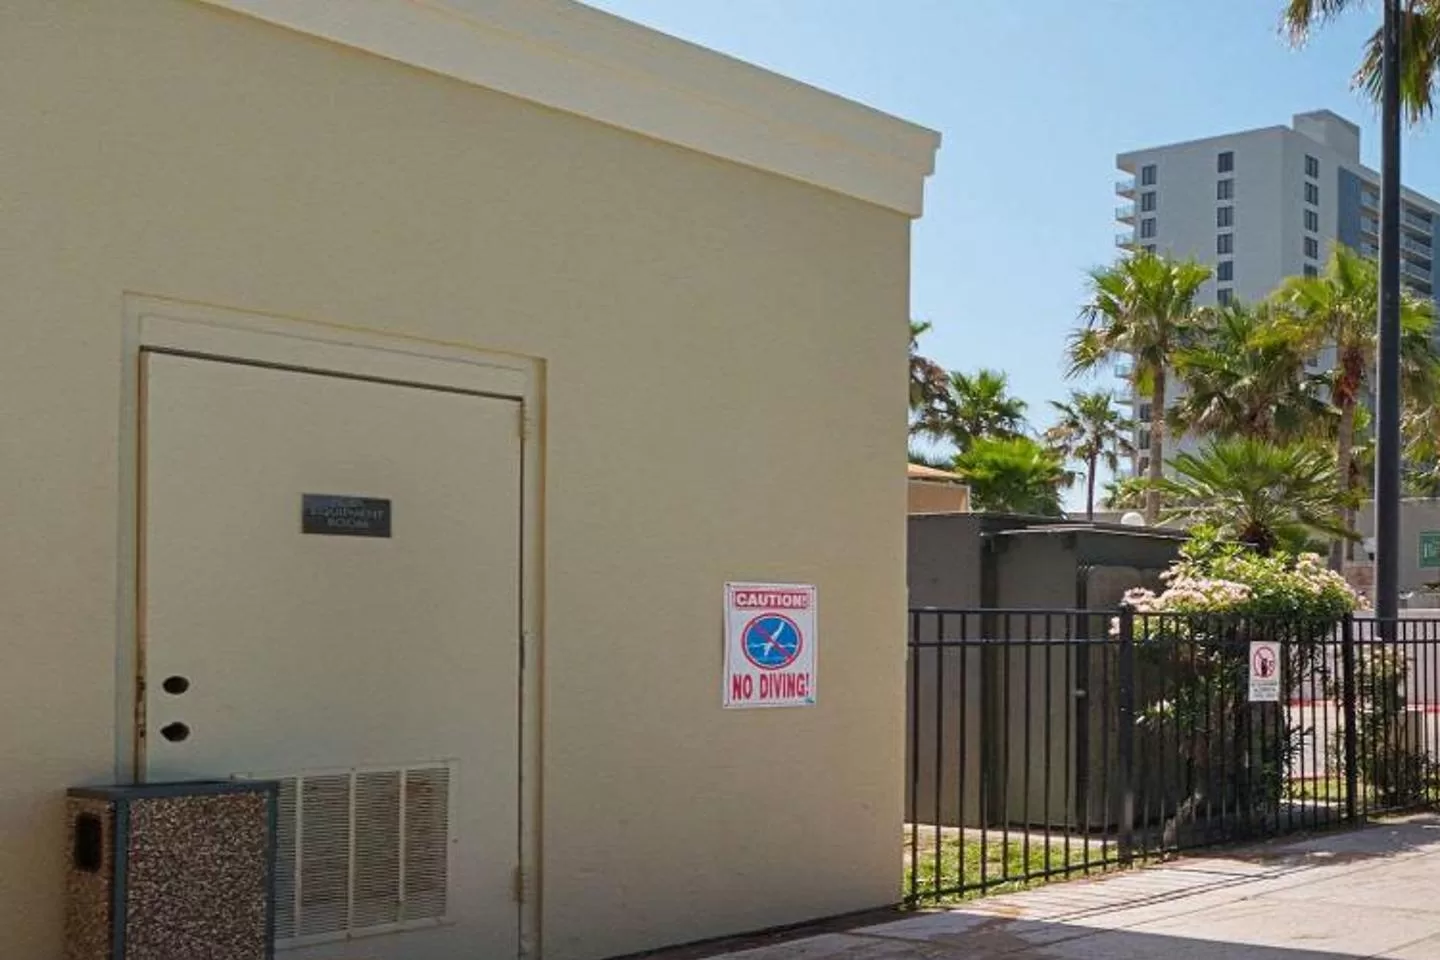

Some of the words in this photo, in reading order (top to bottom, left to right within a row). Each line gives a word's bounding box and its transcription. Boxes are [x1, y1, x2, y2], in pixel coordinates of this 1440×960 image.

[736, 592, 807, 608] CAUTION!
[732, 673, 753, 701] NO
[759, 672, 810, 700] DIVING!
